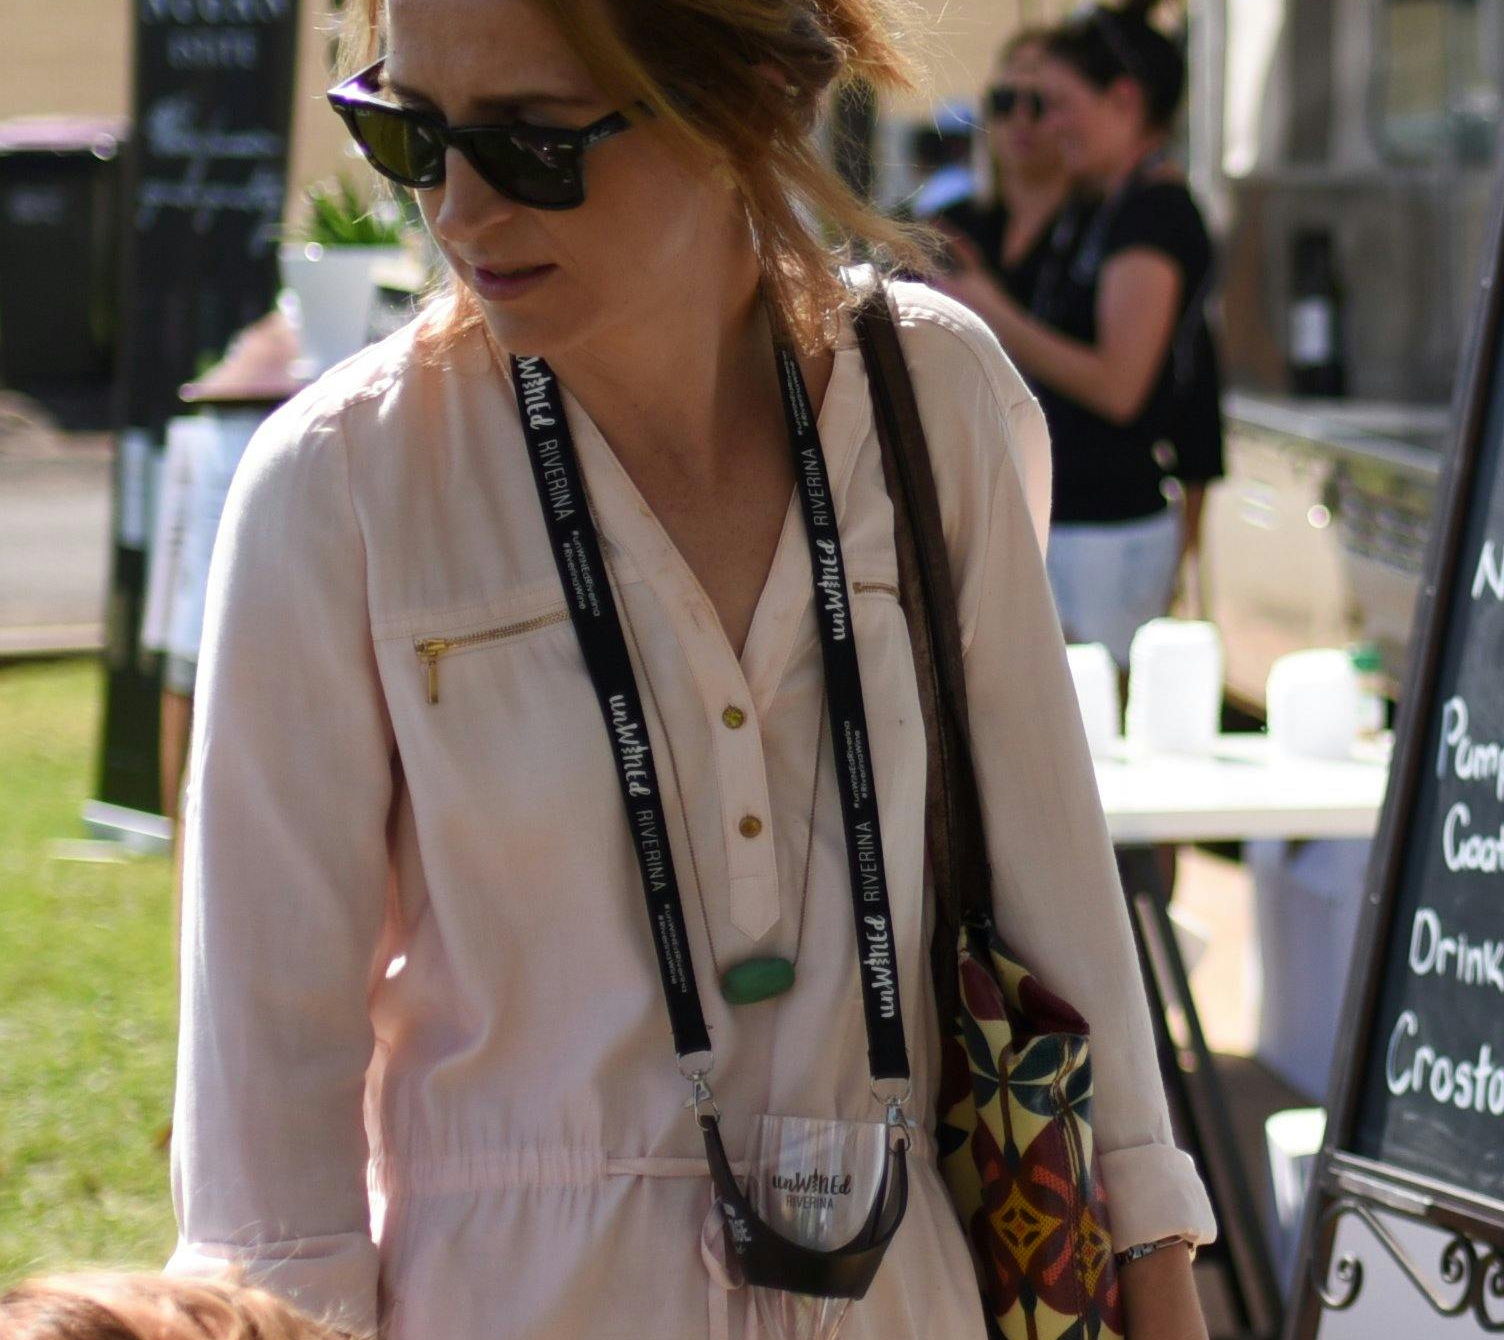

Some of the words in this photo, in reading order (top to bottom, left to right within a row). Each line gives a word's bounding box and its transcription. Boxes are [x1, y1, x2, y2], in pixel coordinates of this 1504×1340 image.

[538, 438, 576, 521] RIVERINA
[801, 448, 829, 526] RIVERINA
[635, 809, 666, 893] RIVERINA
[855, 820, 880, 903] RIVERINA
[786, 1194, 834, 1210] RIVERINA
